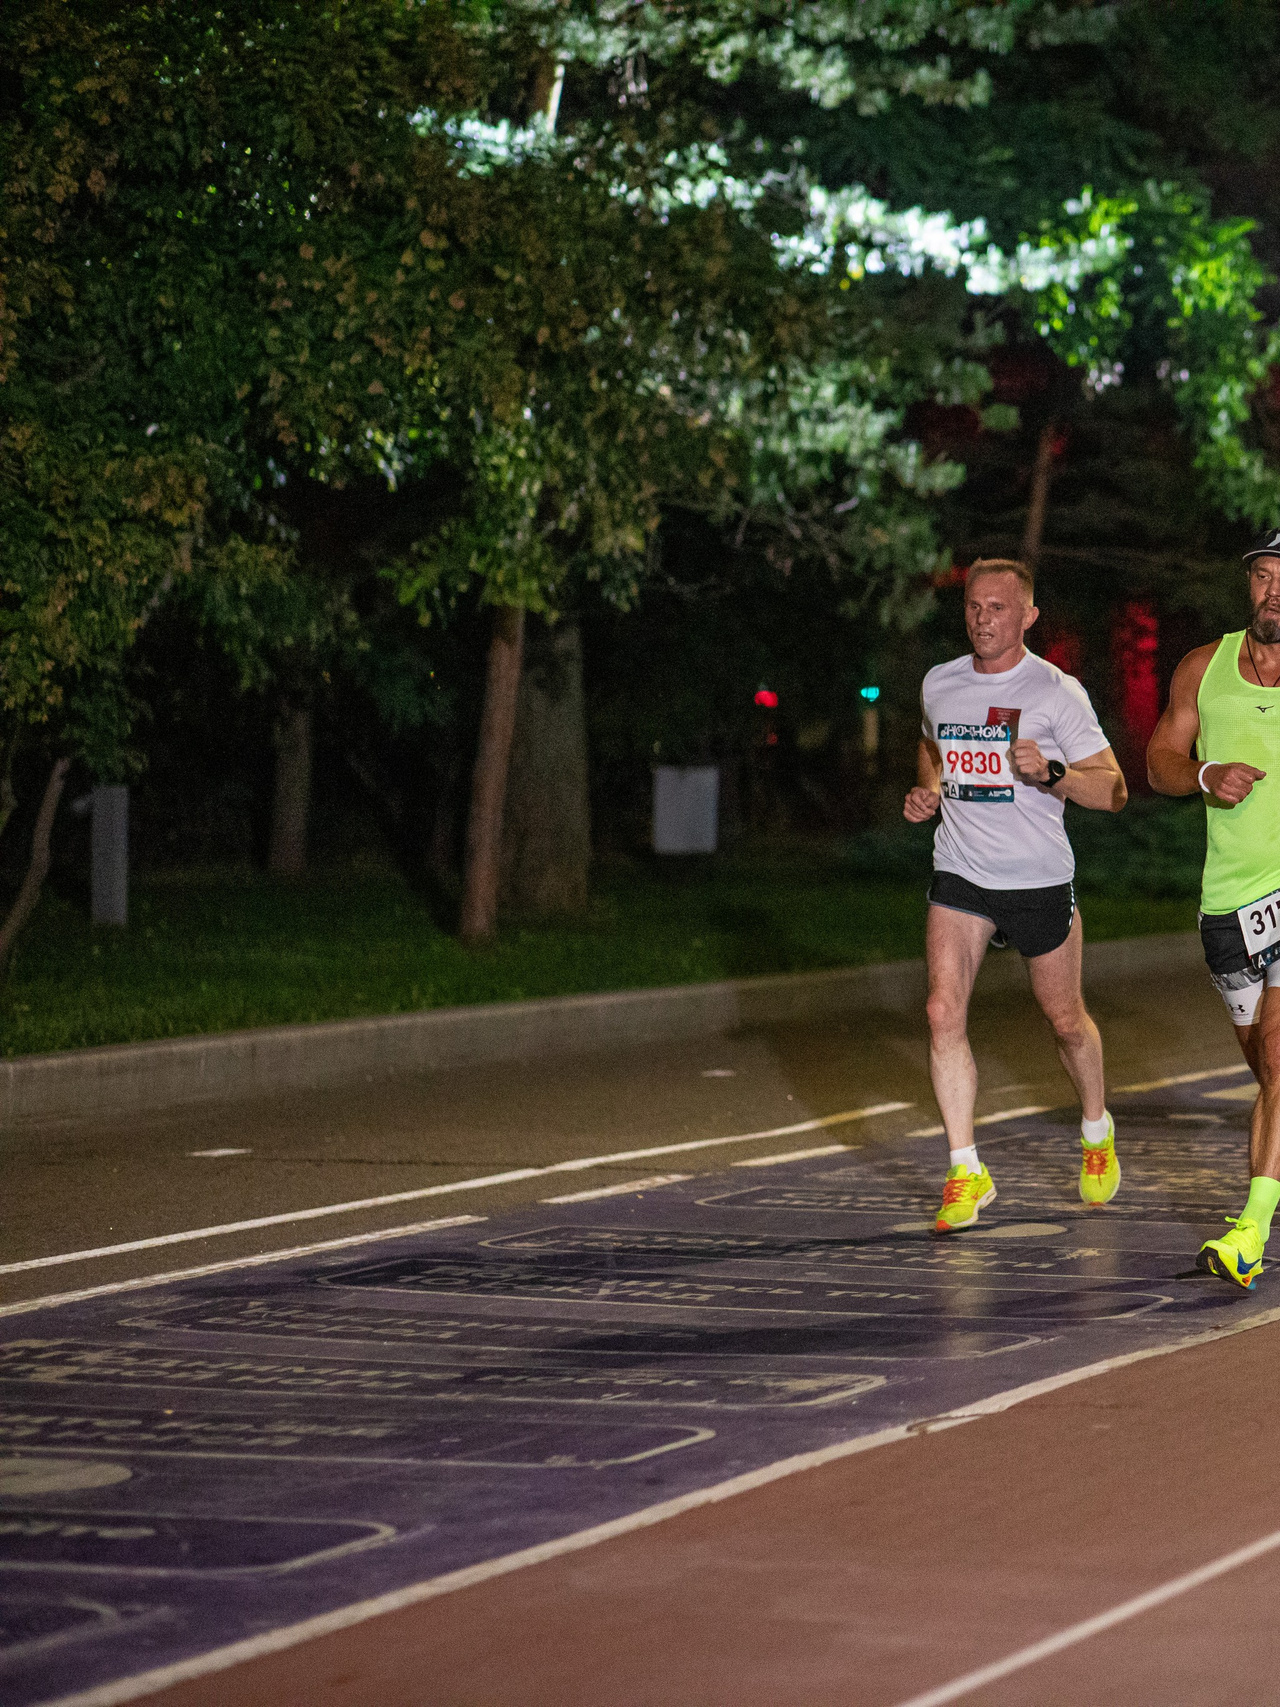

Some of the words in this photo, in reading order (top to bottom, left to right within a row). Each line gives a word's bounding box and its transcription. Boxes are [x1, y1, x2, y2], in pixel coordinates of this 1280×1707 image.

[946, 750, 1002, 775] 9830
[903, 1256, 1056, 1269] ноги
[398, 1275, 470, 1286] 10
[480, 1282, 715, 1301] секунд
[421, 1265, 804, 1295] Потянитесь
[825, 1290, 934, 1300] так
[199, 1316, 461, 1339] вперед
[239, 1307, 699, 1338] Наклонитесь
[227, 1376, 412, 1389] ноги
[476, 1374, 707, 1387] носок
